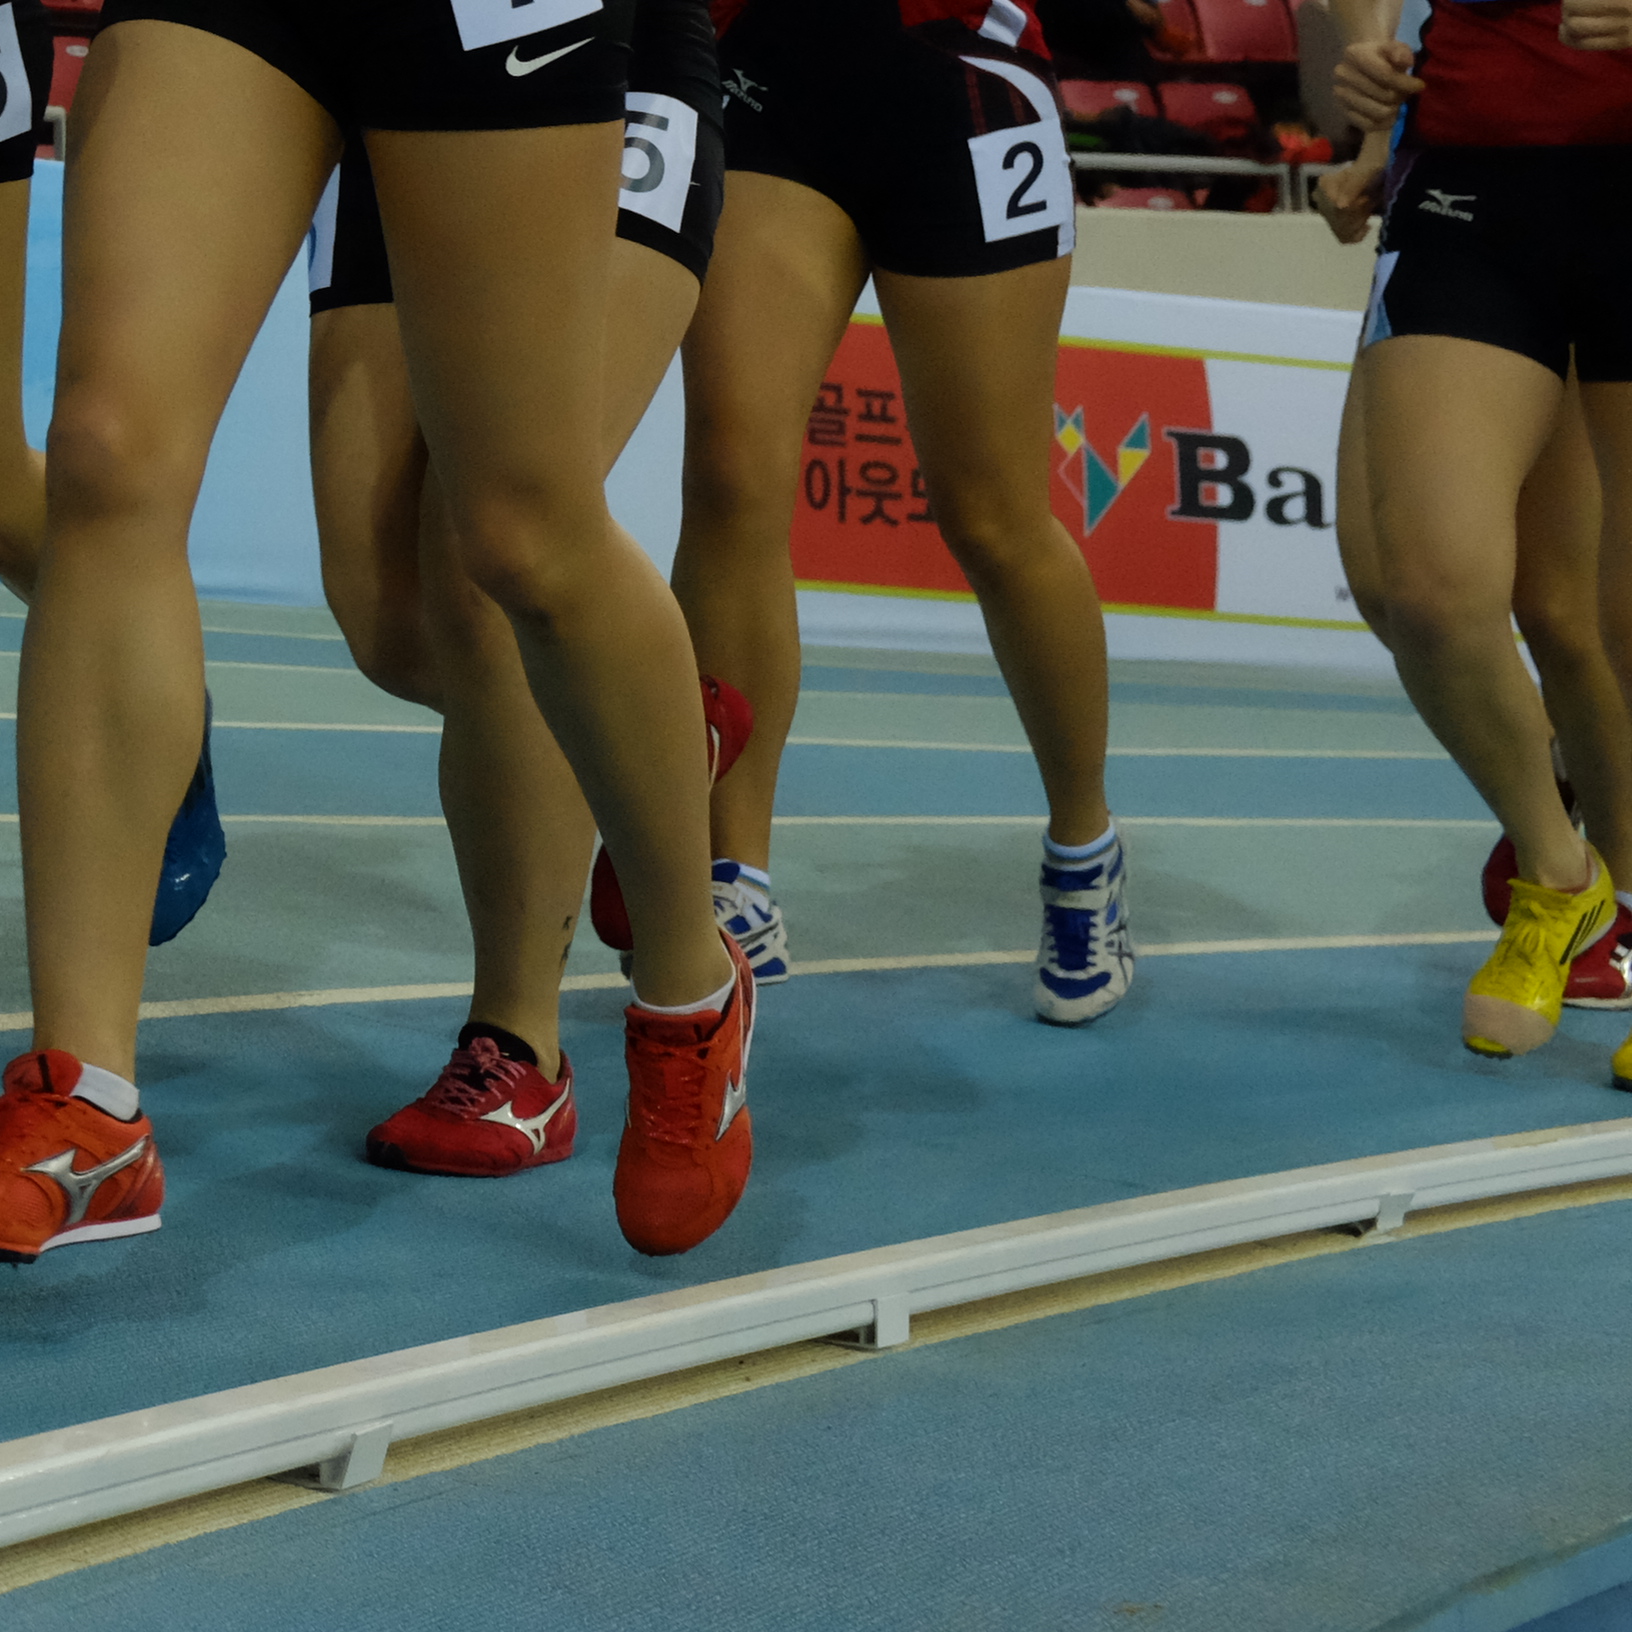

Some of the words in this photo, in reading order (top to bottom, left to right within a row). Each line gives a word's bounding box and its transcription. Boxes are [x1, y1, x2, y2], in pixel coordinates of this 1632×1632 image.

[1001, 141, 1048, 220] 2
[808, 381, 903, 448] 골프
[1165, 428, 1332, 529] Ba
